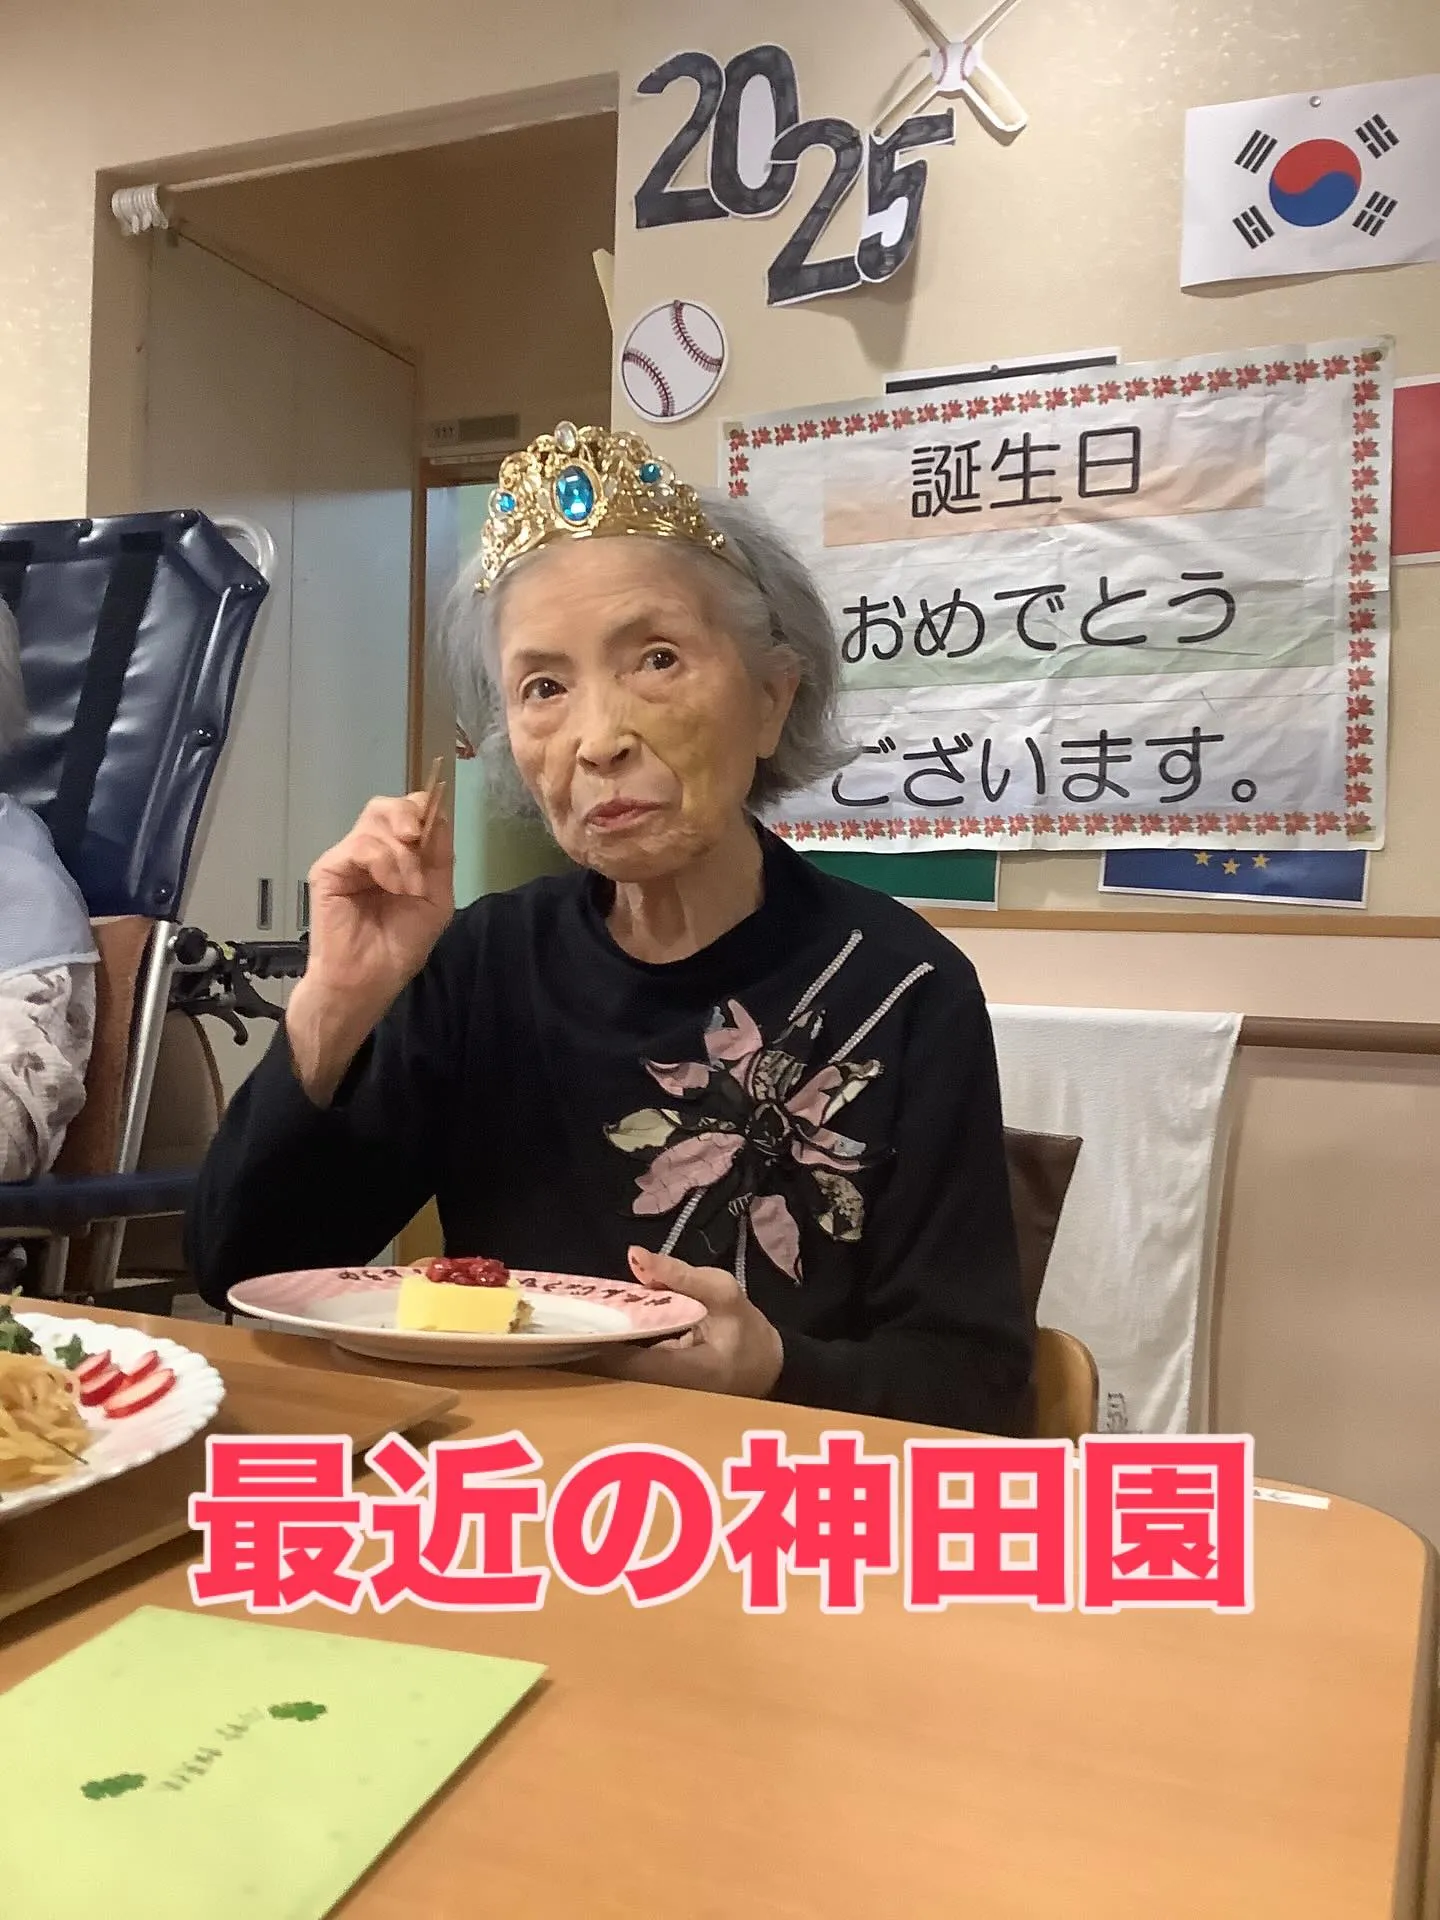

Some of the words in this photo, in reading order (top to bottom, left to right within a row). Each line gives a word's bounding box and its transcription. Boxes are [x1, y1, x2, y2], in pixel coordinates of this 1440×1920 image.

[635, 45, 956, 305] 2025
[911, 426, 1141, 518] 誕生日
[841, 571, 1236, 664] おめでとう
[831, 726, 1257, 806] ございます。
